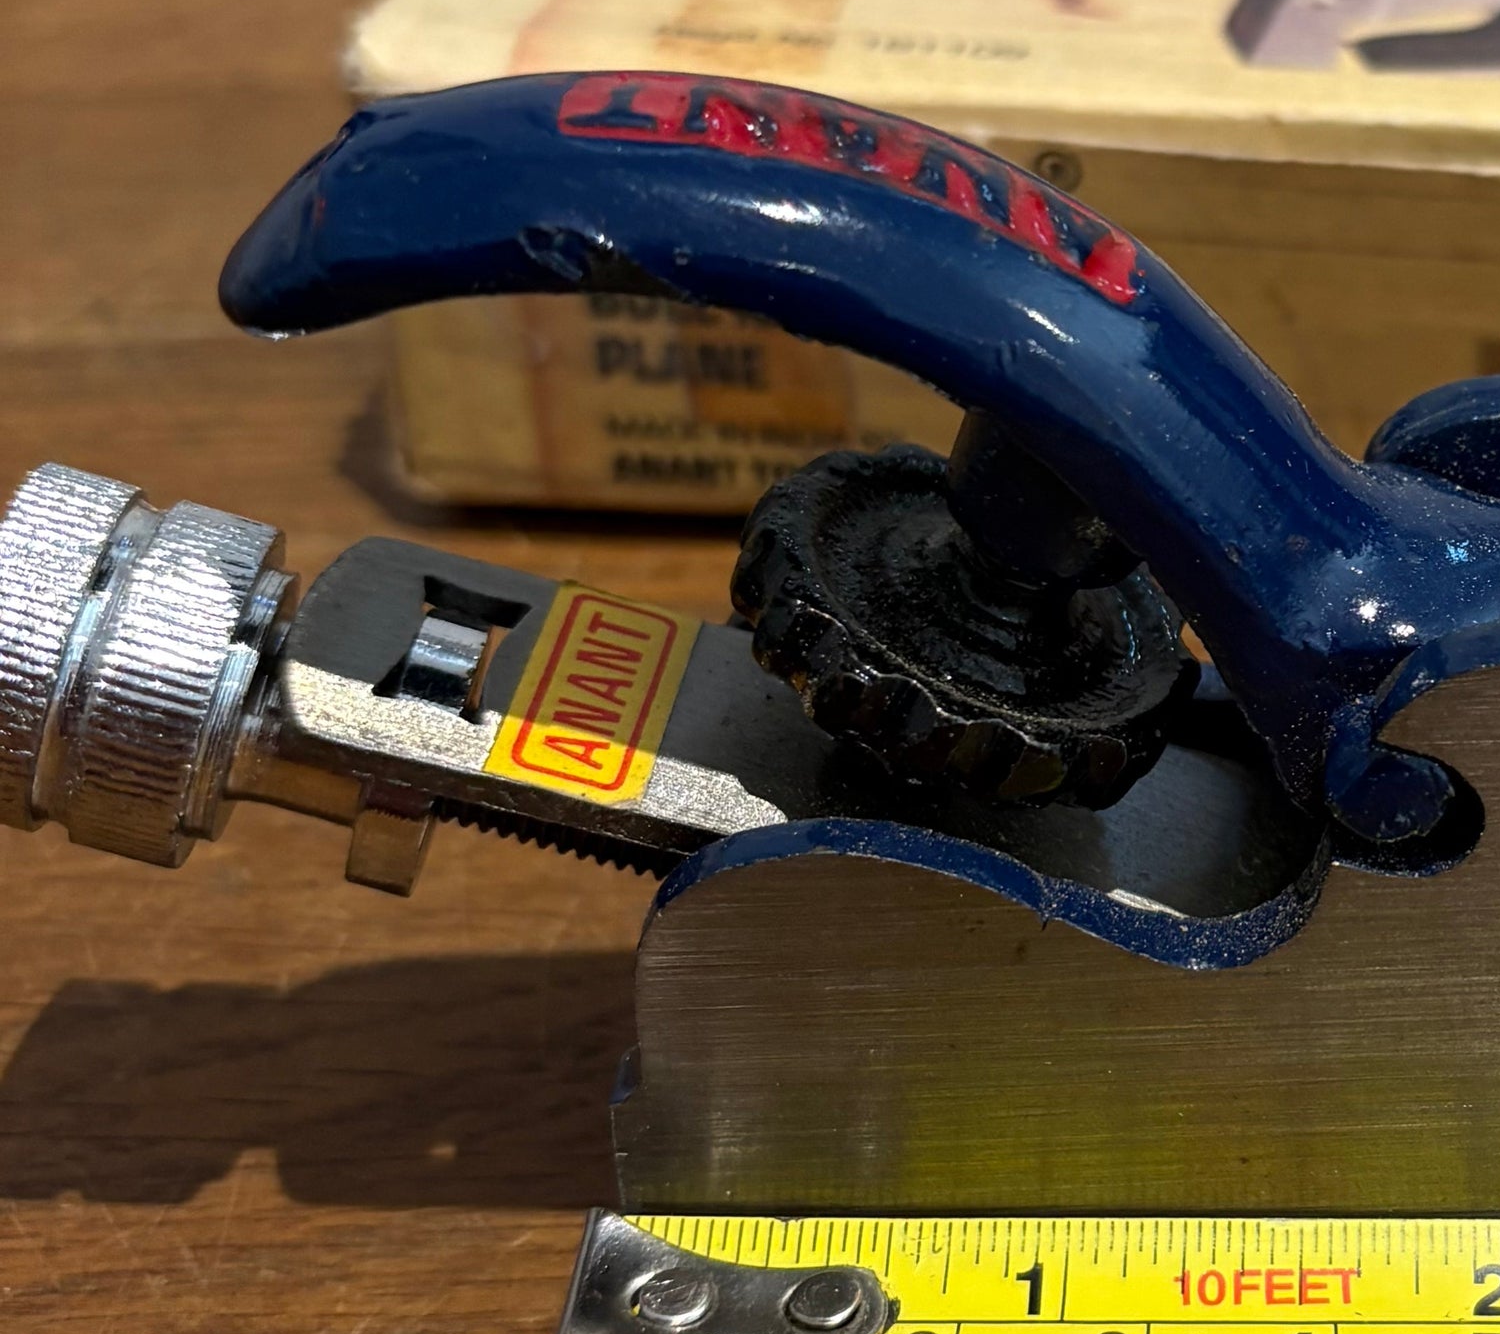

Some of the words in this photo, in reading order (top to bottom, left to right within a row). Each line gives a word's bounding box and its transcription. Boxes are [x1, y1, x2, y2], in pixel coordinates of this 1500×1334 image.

[594, 335, 769, 392] PLANE
[542, 611, 652, 771] ANANT
[1015, 1263, 1043, 1316] 1
